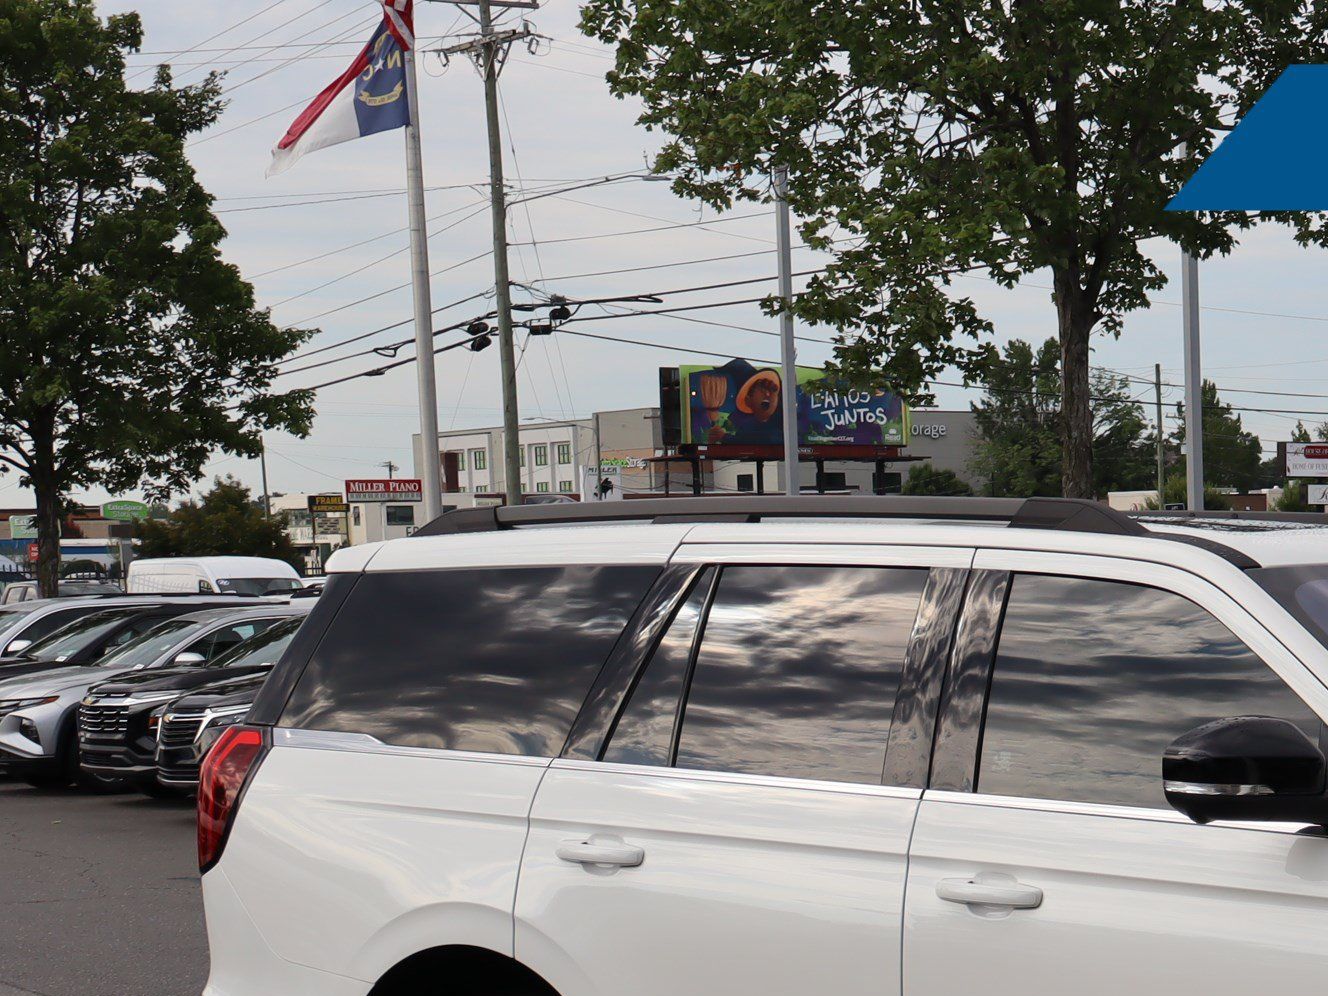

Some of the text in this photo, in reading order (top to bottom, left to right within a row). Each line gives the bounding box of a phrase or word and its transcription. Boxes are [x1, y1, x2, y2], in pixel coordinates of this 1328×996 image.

[911, 424, 947, 439] orage
[349, 481, 419, 493] MILLER PIANO
